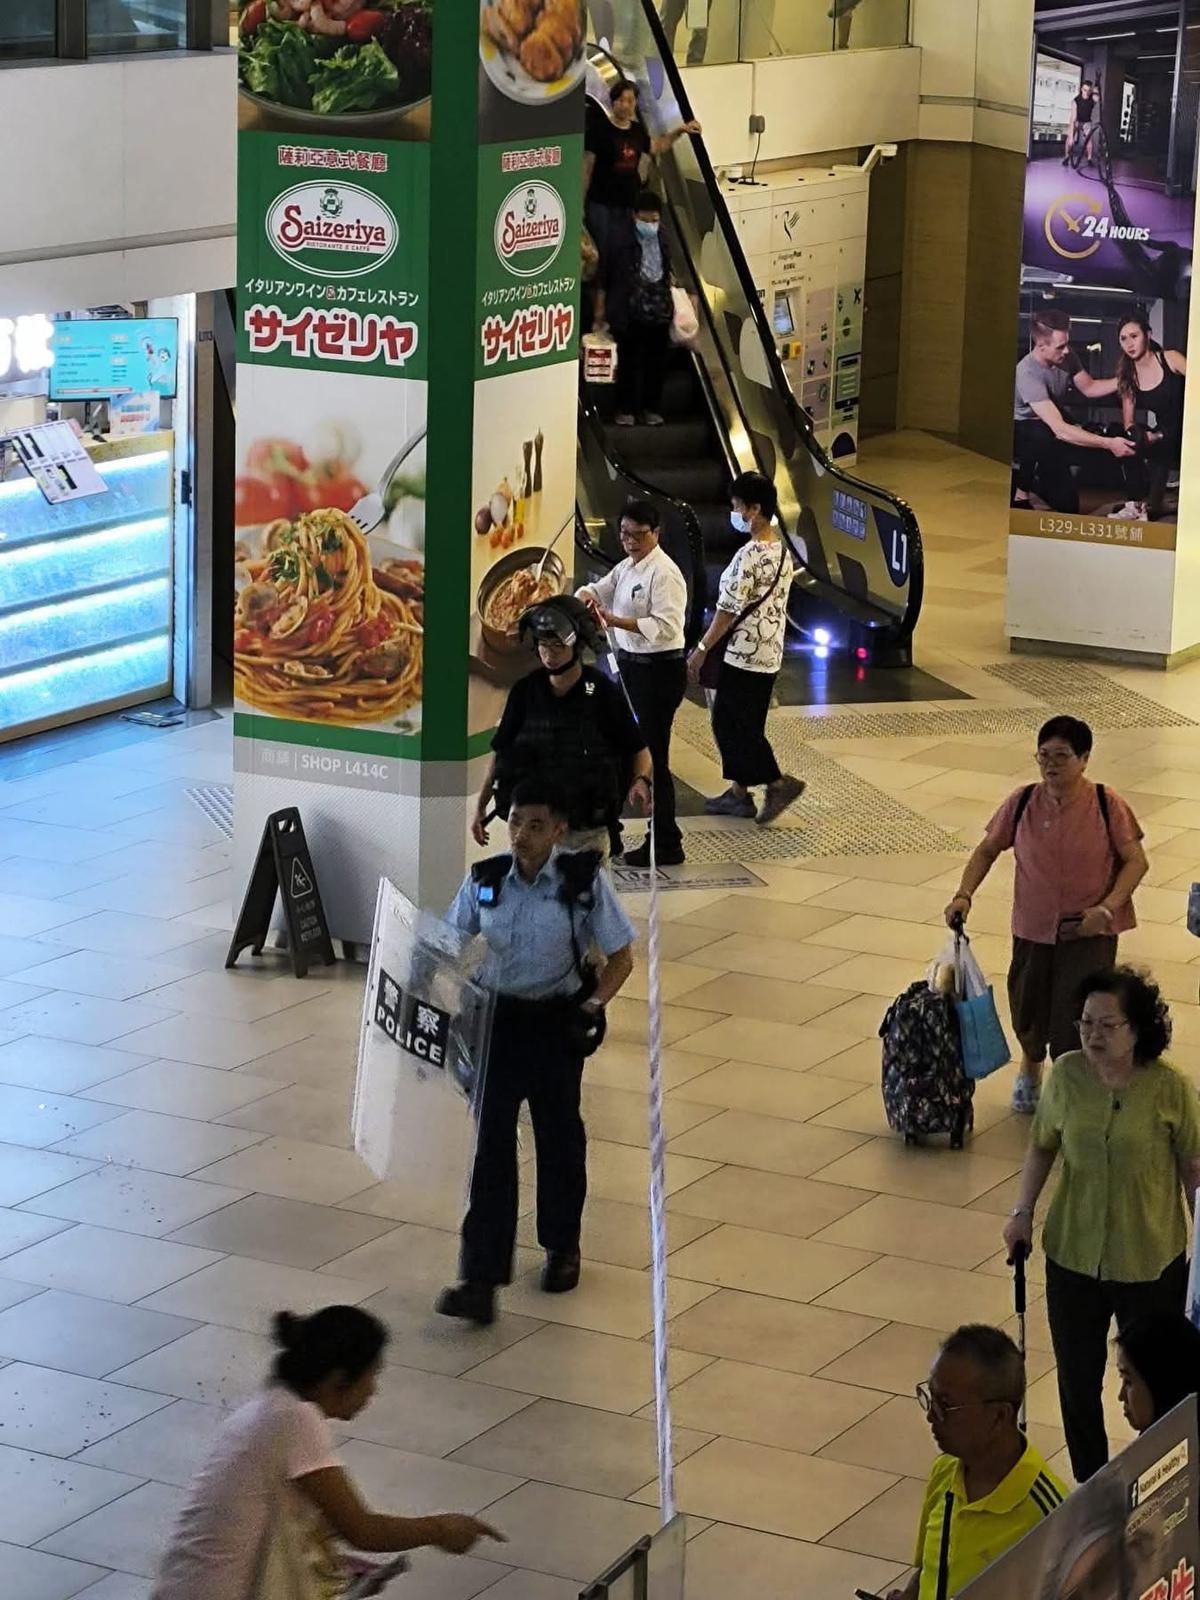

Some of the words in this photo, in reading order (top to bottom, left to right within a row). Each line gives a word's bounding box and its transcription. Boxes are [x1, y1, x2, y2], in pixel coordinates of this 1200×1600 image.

[278, 204, 386, 248] Saizeriya
[501, 211, 559, 254] Saizeriya
[1081, 215, 1109, 238] 24
[1109, 226, 1150, 241] HOURS
[246, 304, 417, 365] サイゼリヤ
[482, 303, 574, 365] サイゼリヤ
[891, 529, 908, 575] L1
[300, 753, 341, 773] SHOP
[344, 760, 389, 779] L414C
[376, 1004, 443, 1064] POLICE
